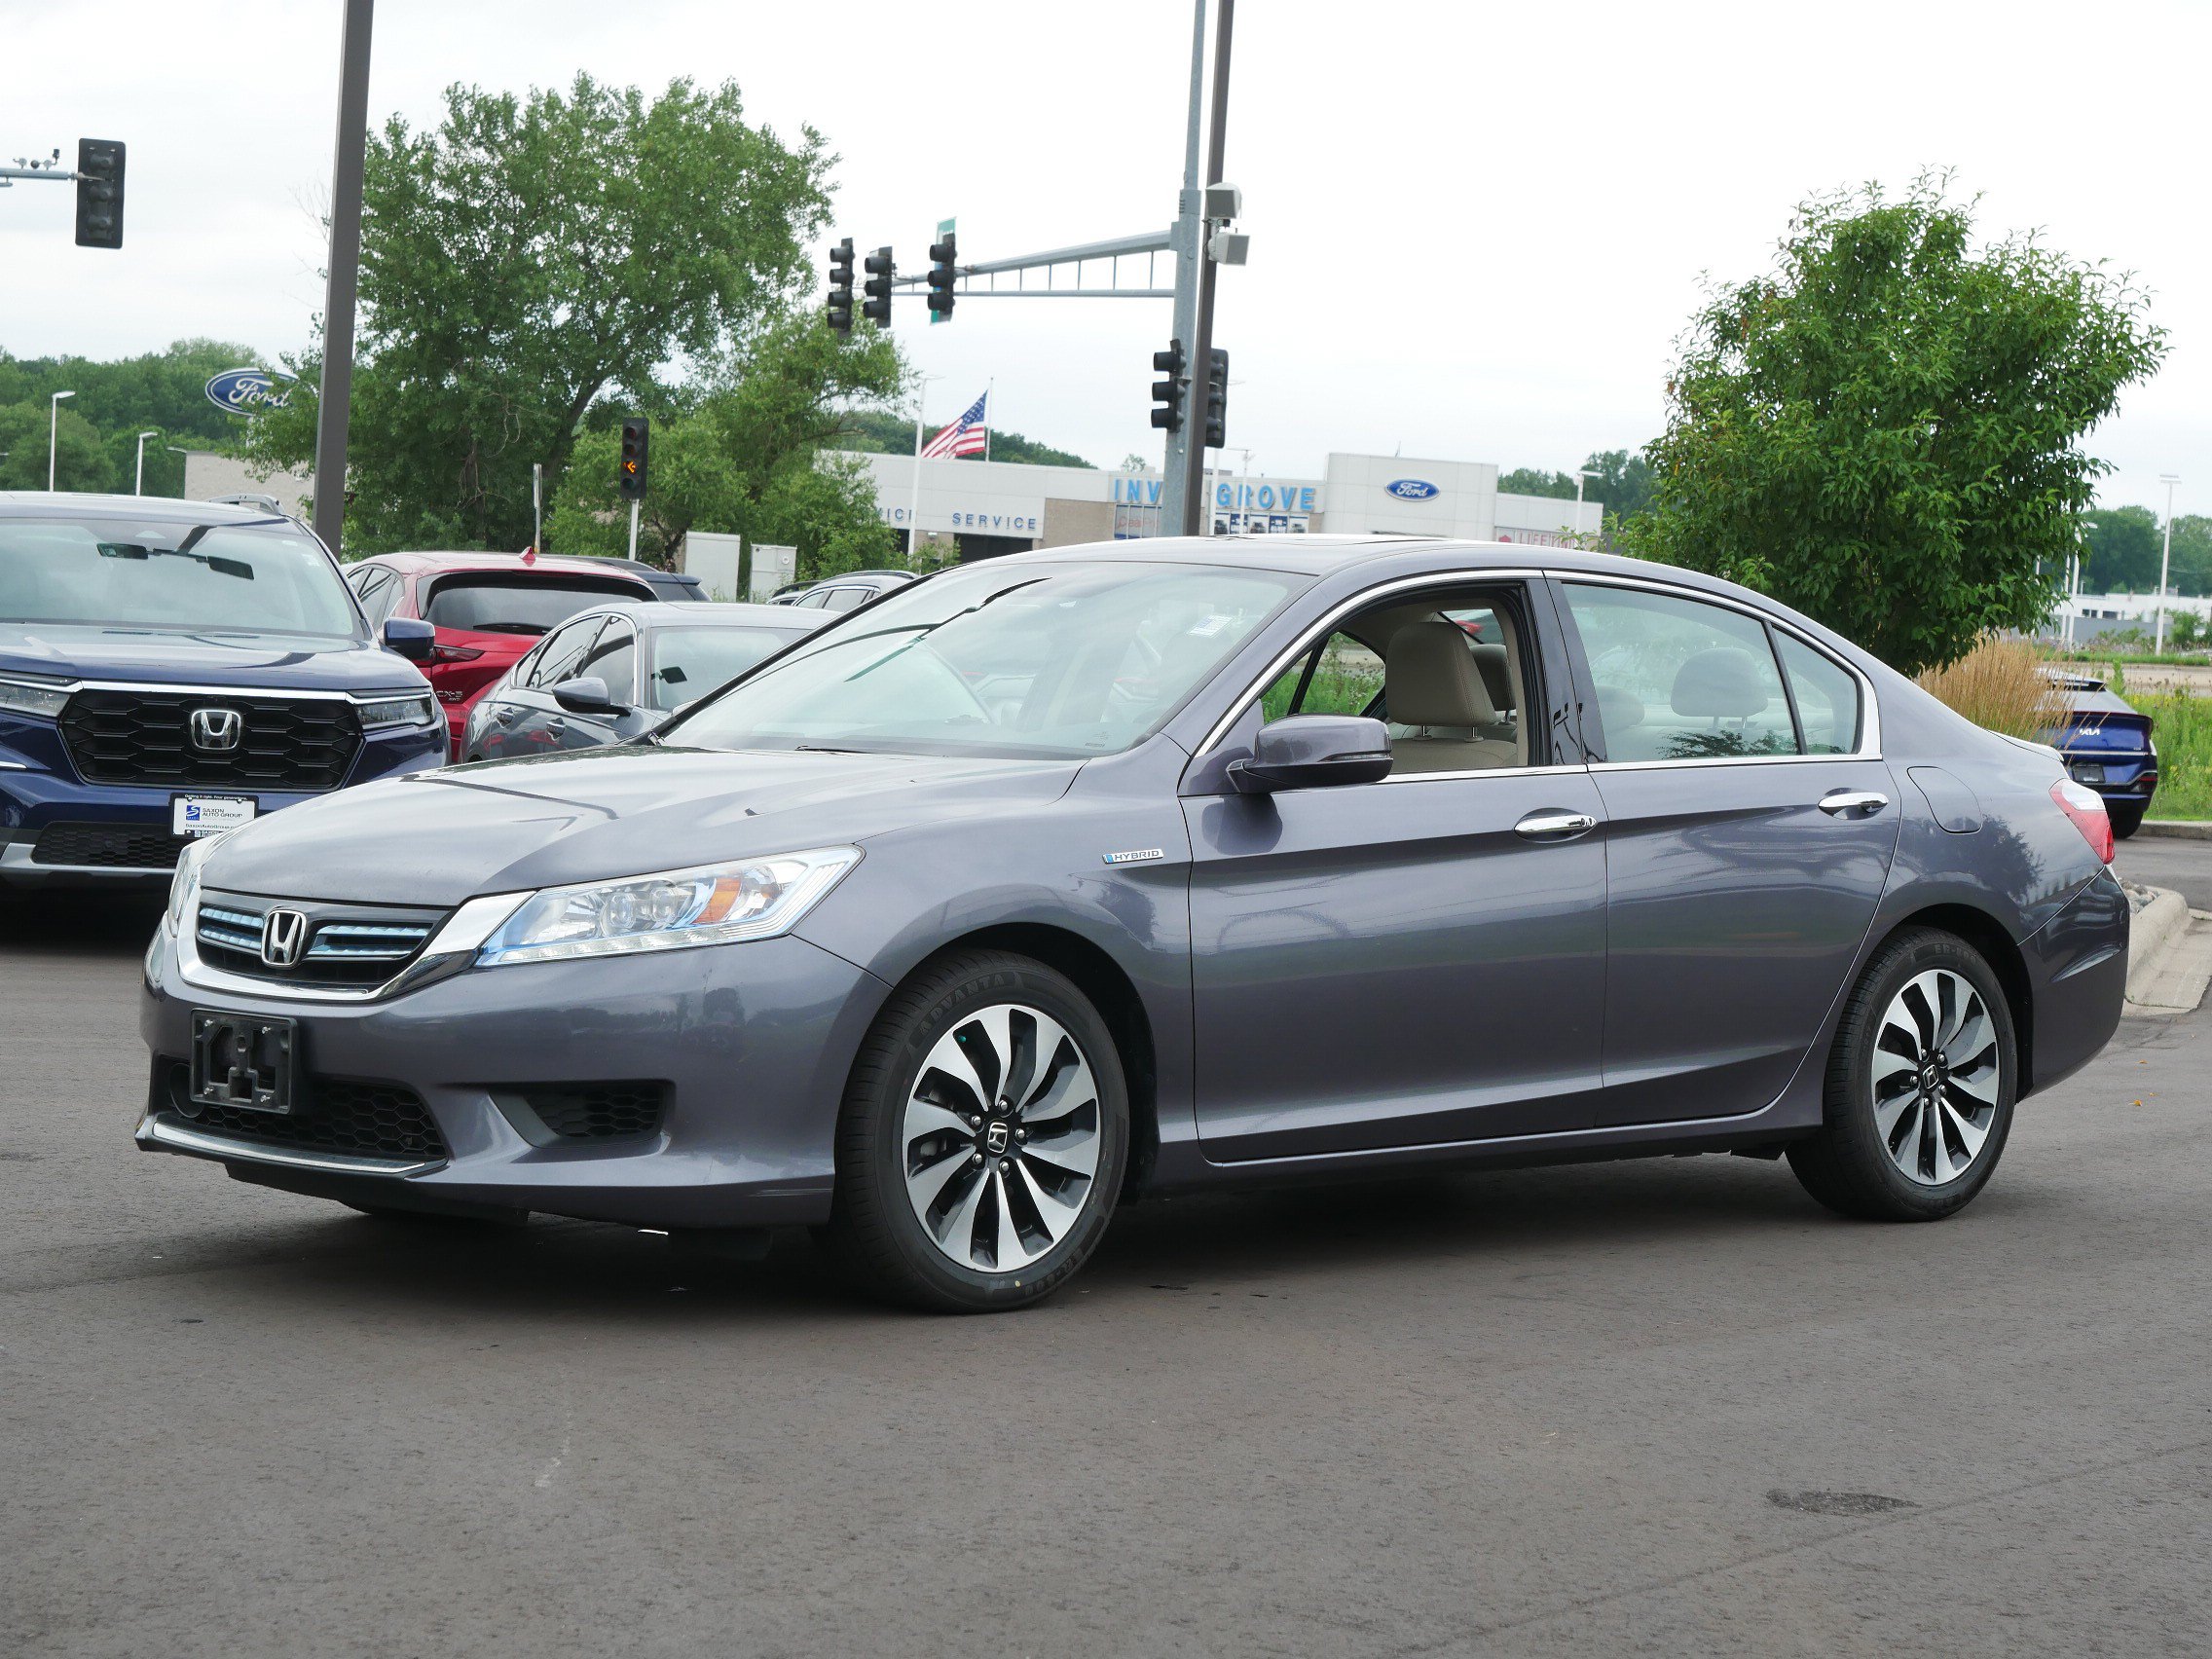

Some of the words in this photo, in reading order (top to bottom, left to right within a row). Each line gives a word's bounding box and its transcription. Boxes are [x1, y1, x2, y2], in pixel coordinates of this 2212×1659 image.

[228, 377, 293, 407] Ford
[1217, 483, 1316, 510] GROVE
[1396, 482, 1429, 498] Ford
[952, 512, 1036, 530] SERVICE
[1115, 850, 1160, 861] HYBRID
